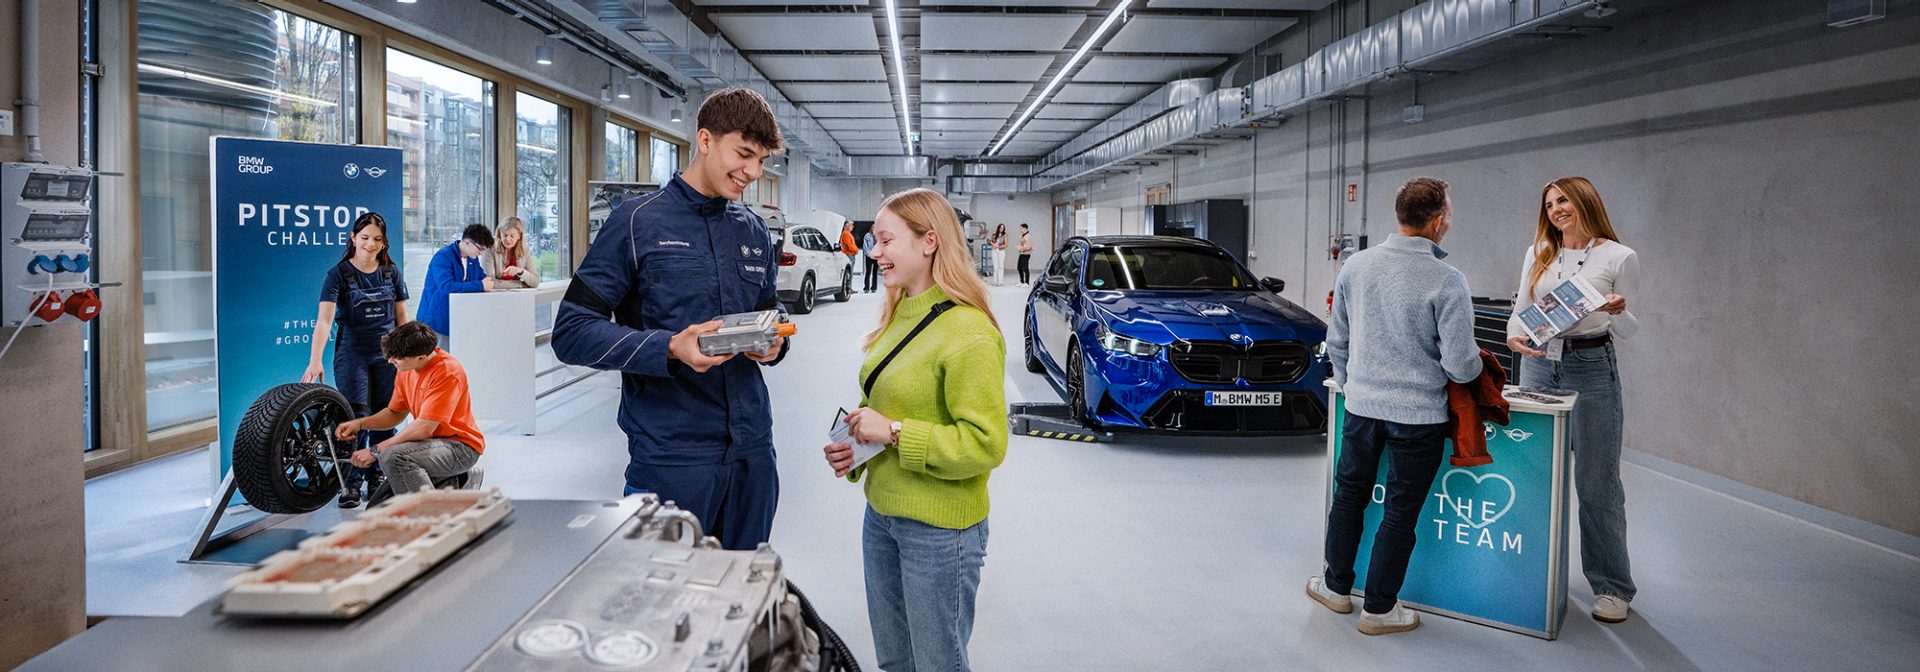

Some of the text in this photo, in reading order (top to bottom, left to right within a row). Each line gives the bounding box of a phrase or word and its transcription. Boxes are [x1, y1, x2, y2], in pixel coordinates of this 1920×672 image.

[238, 155, 265, 165] BMW
[238, 164, 274, 174] GROUP
[267, 230, 347, 246] CHALLE
[1213, 393, 1280, 404] M BMW M5 E
[1434, 493, 1497, 523] THE
[1433, 518, 1523, 555] TEAM
